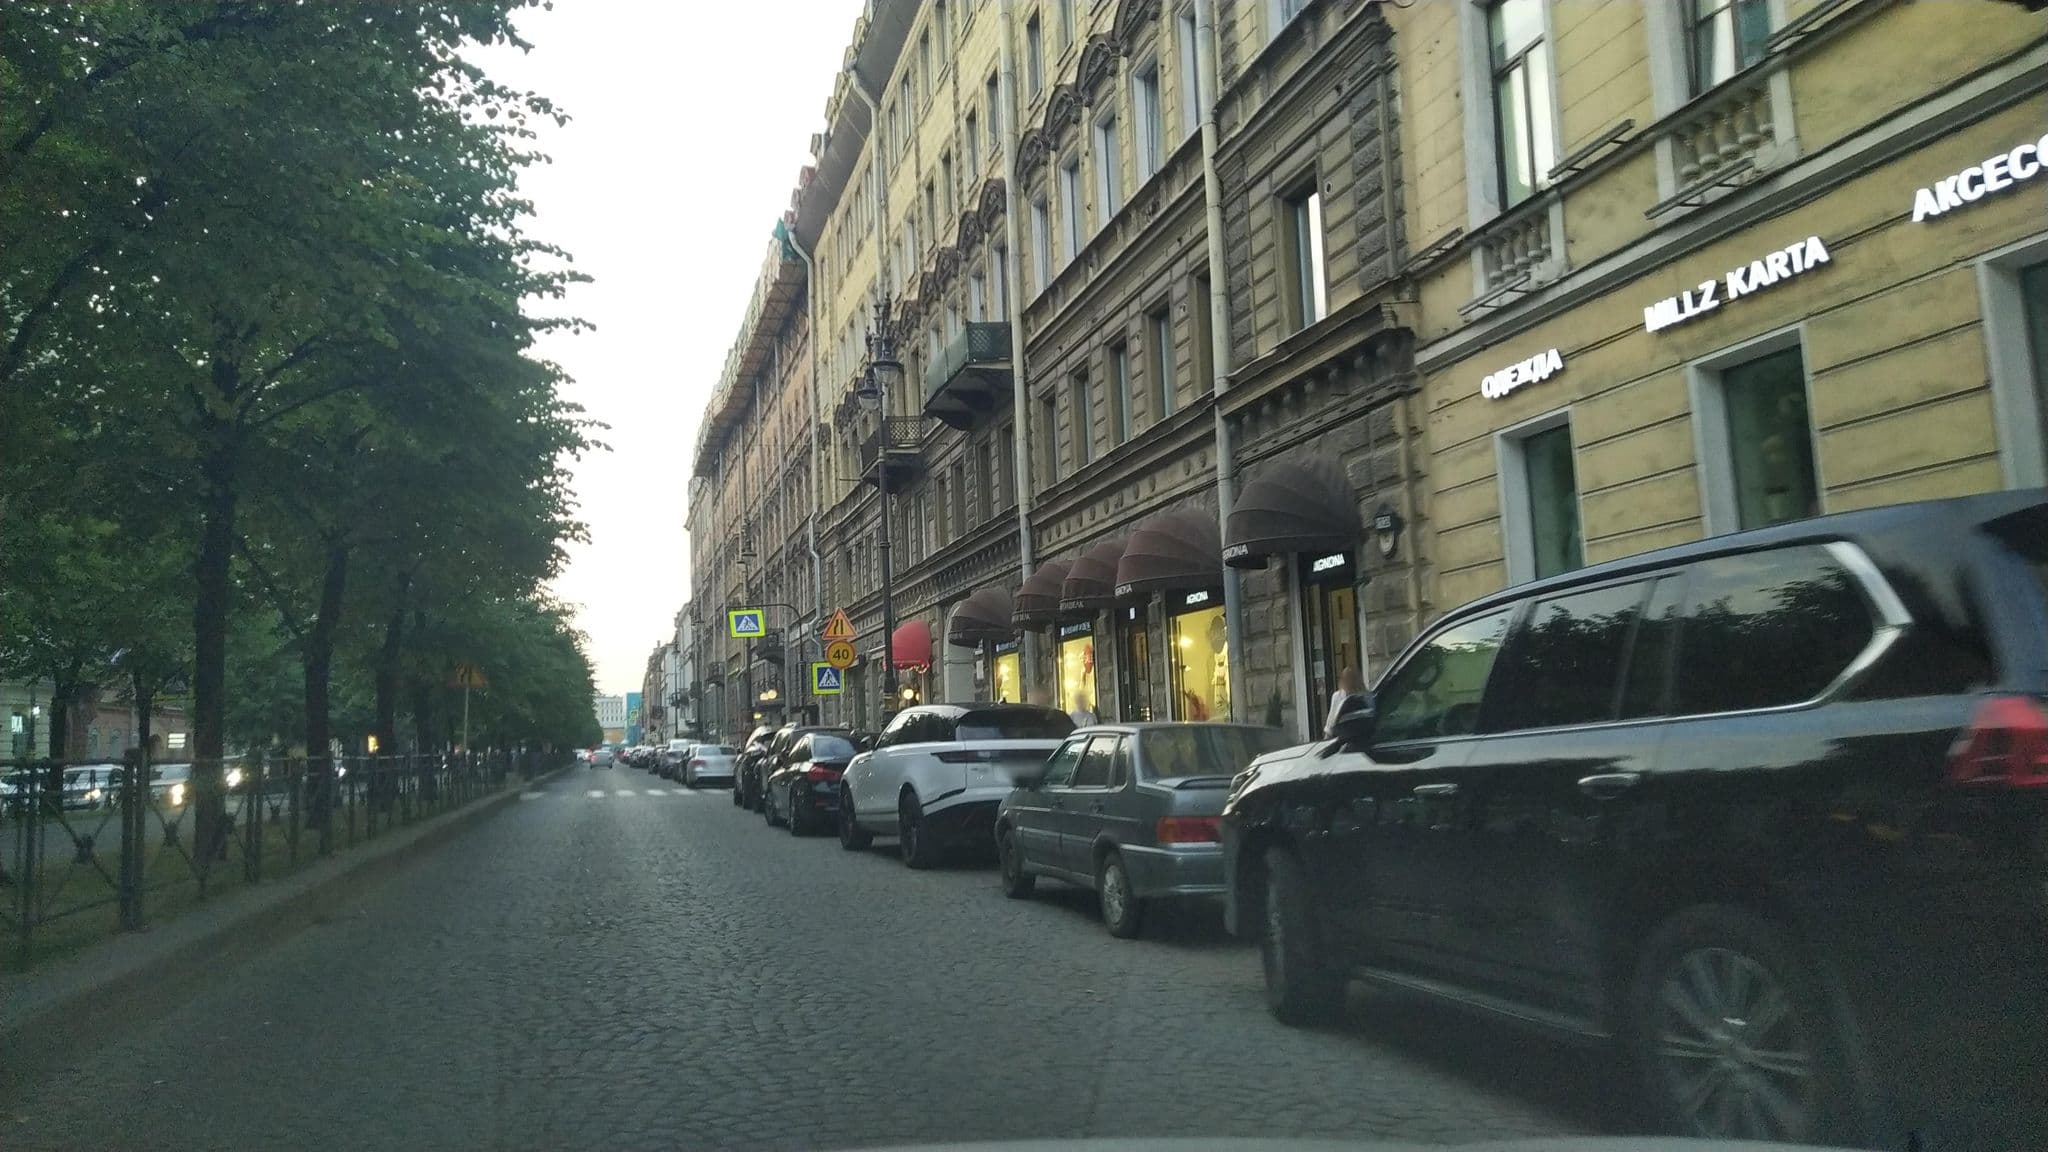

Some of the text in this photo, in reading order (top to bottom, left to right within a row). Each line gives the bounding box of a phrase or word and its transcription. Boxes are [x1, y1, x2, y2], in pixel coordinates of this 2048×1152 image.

[1726, 236, 1830, 299] KARTA
[1481, 348, 1564, 399] ОДЕЖДА
[833, 649, 849, 660] 40
